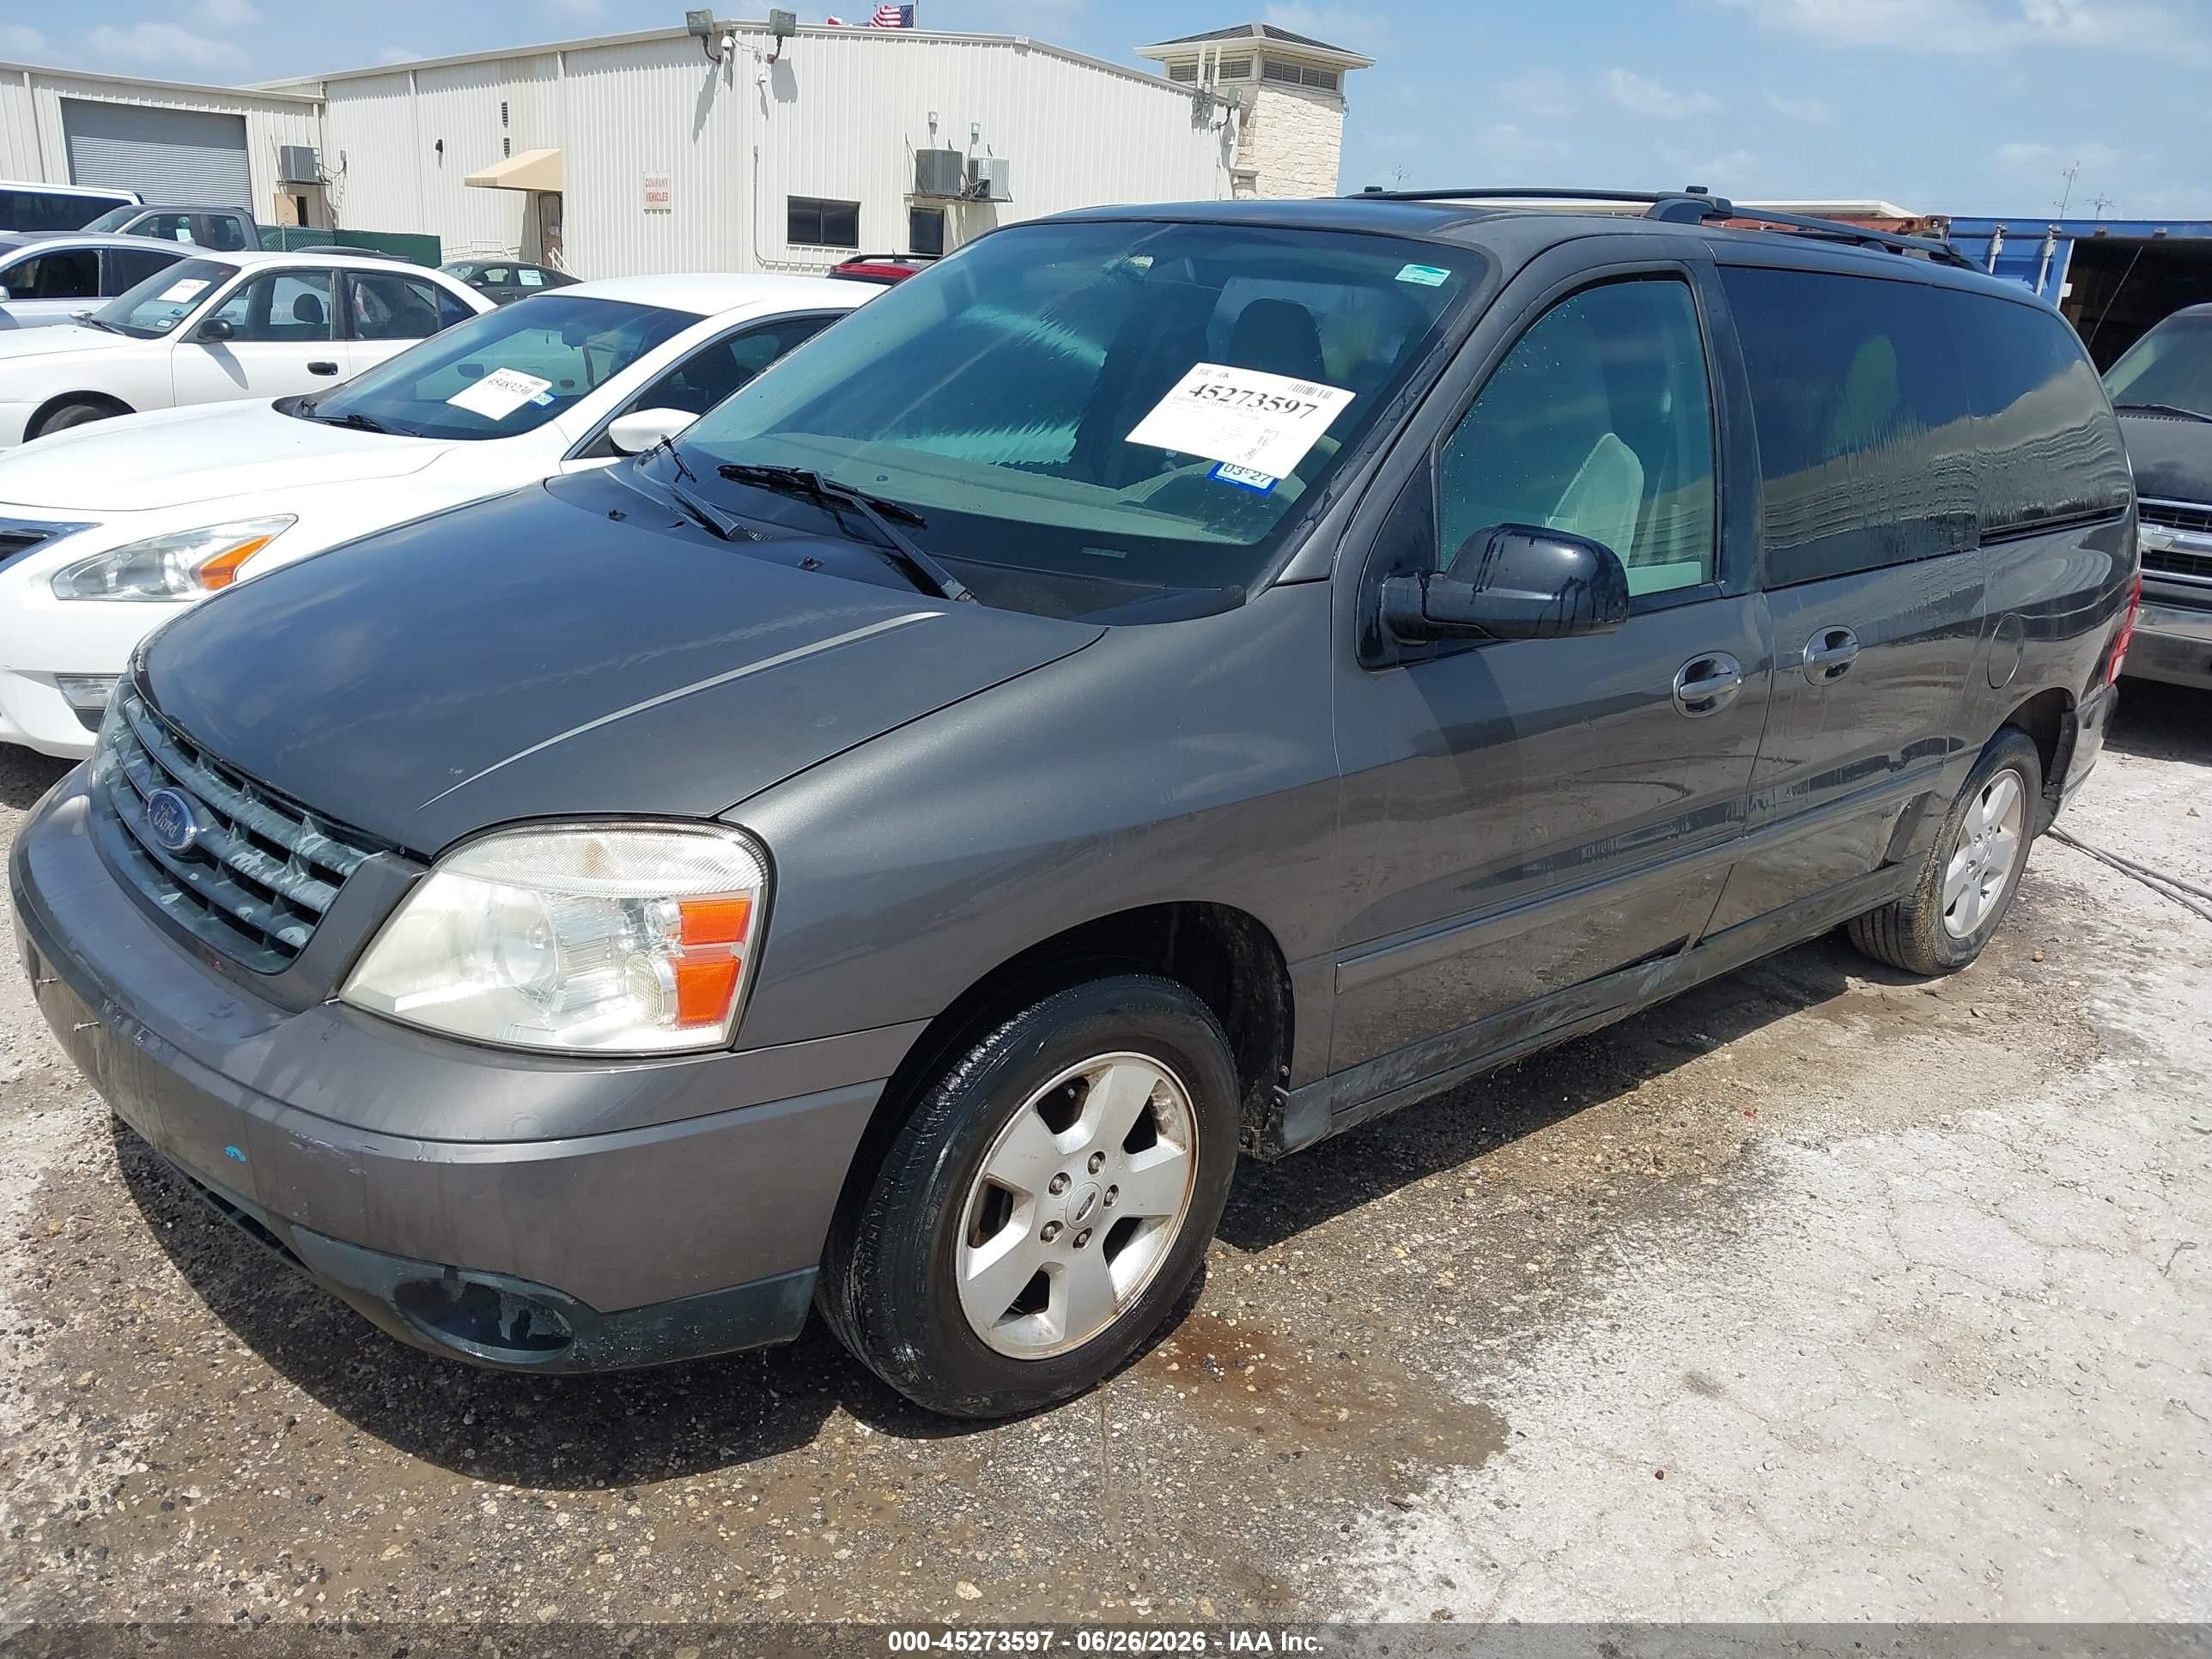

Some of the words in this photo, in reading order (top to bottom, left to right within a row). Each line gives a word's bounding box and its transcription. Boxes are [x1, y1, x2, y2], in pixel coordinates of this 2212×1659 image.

[645, 178, 667, 187] COMPANY
[645, 191, 669, 202] VEHICLES
[1188, 383, 1319, 419] 45273597
[155, 800, 181, 839] Ford
